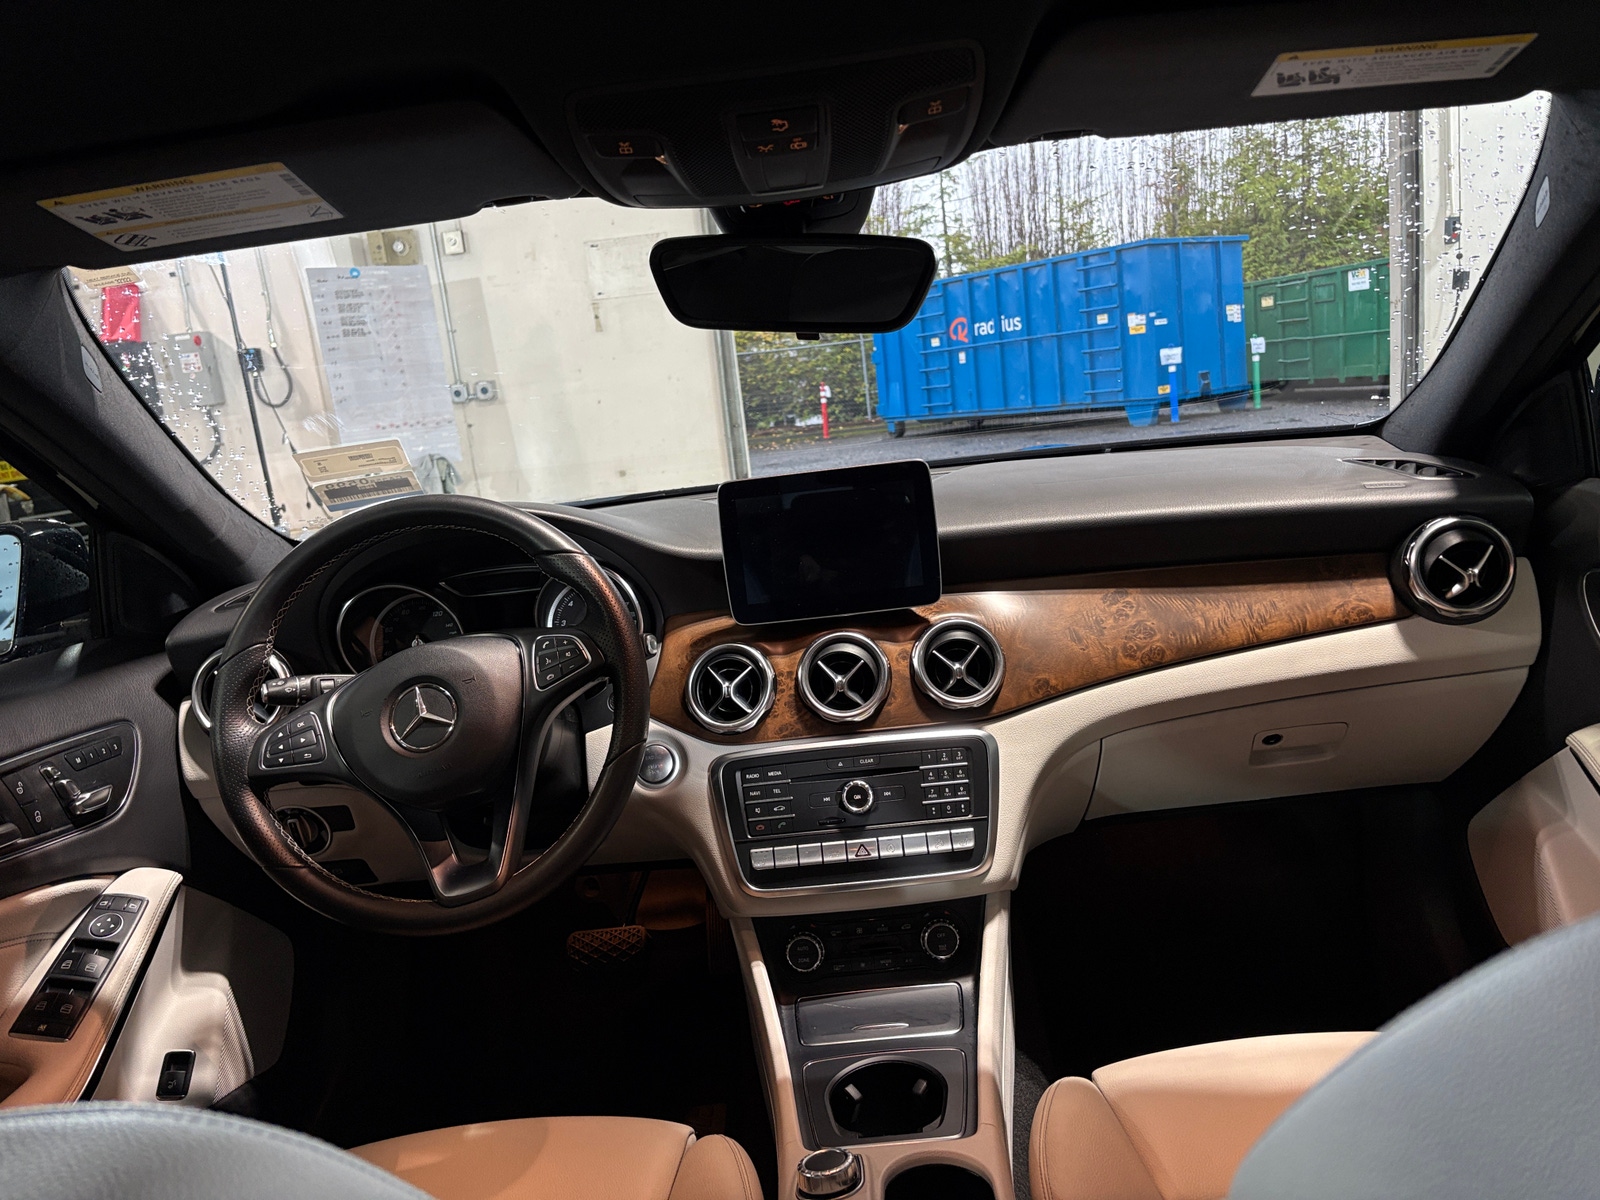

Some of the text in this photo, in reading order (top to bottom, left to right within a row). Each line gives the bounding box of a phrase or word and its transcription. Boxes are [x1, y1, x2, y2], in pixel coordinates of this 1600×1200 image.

[1374, 43, 1439, 54] WARNING
[132, 178, 195, 193] WARNING
[296, 720, 306, 728] OK
